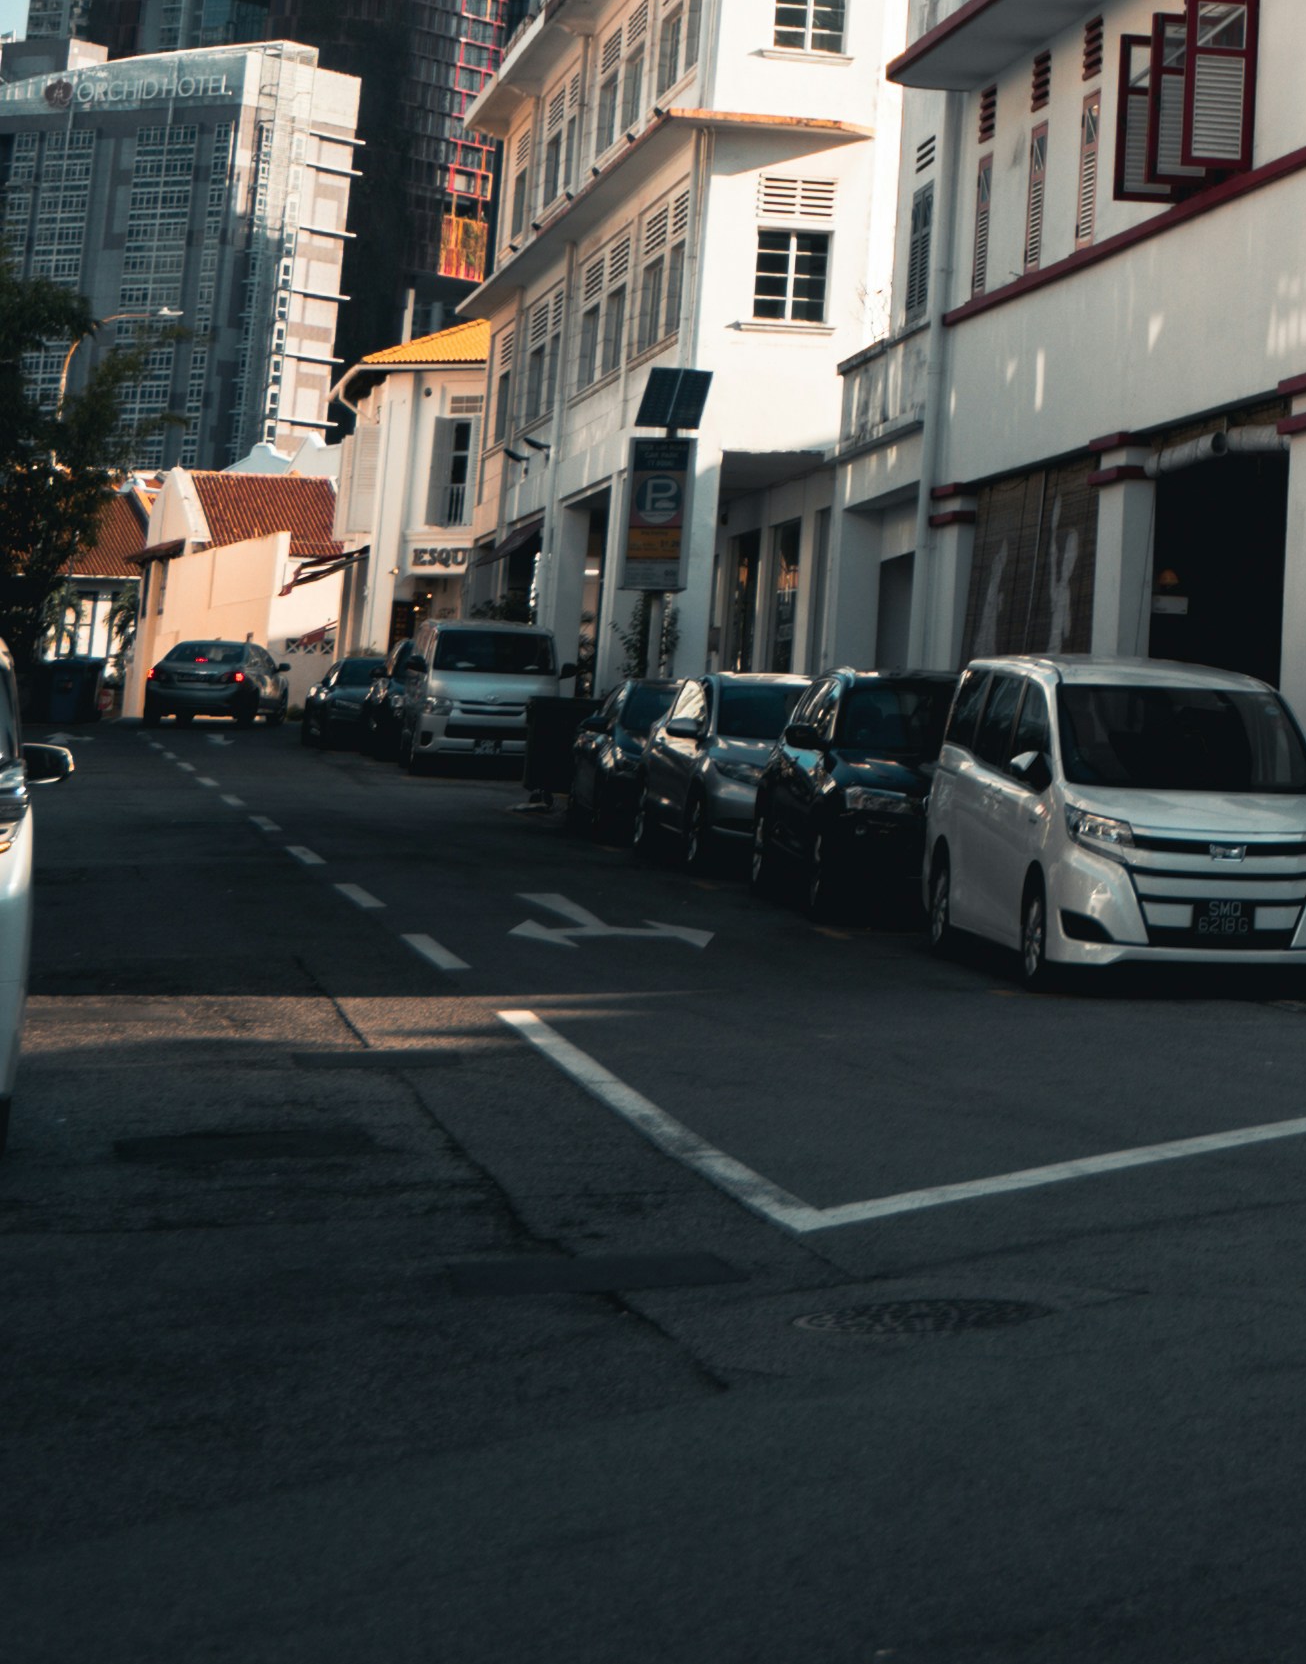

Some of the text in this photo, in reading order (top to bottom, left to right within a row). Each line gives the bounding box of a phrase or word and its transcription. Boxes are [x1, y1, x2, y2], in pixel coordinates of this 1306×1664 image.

[77, 74, 233, 104] ORCHID HOTEL
[412, 548, 468, 567] ESQU
[1198, 917, 1249, 932] 6218G
